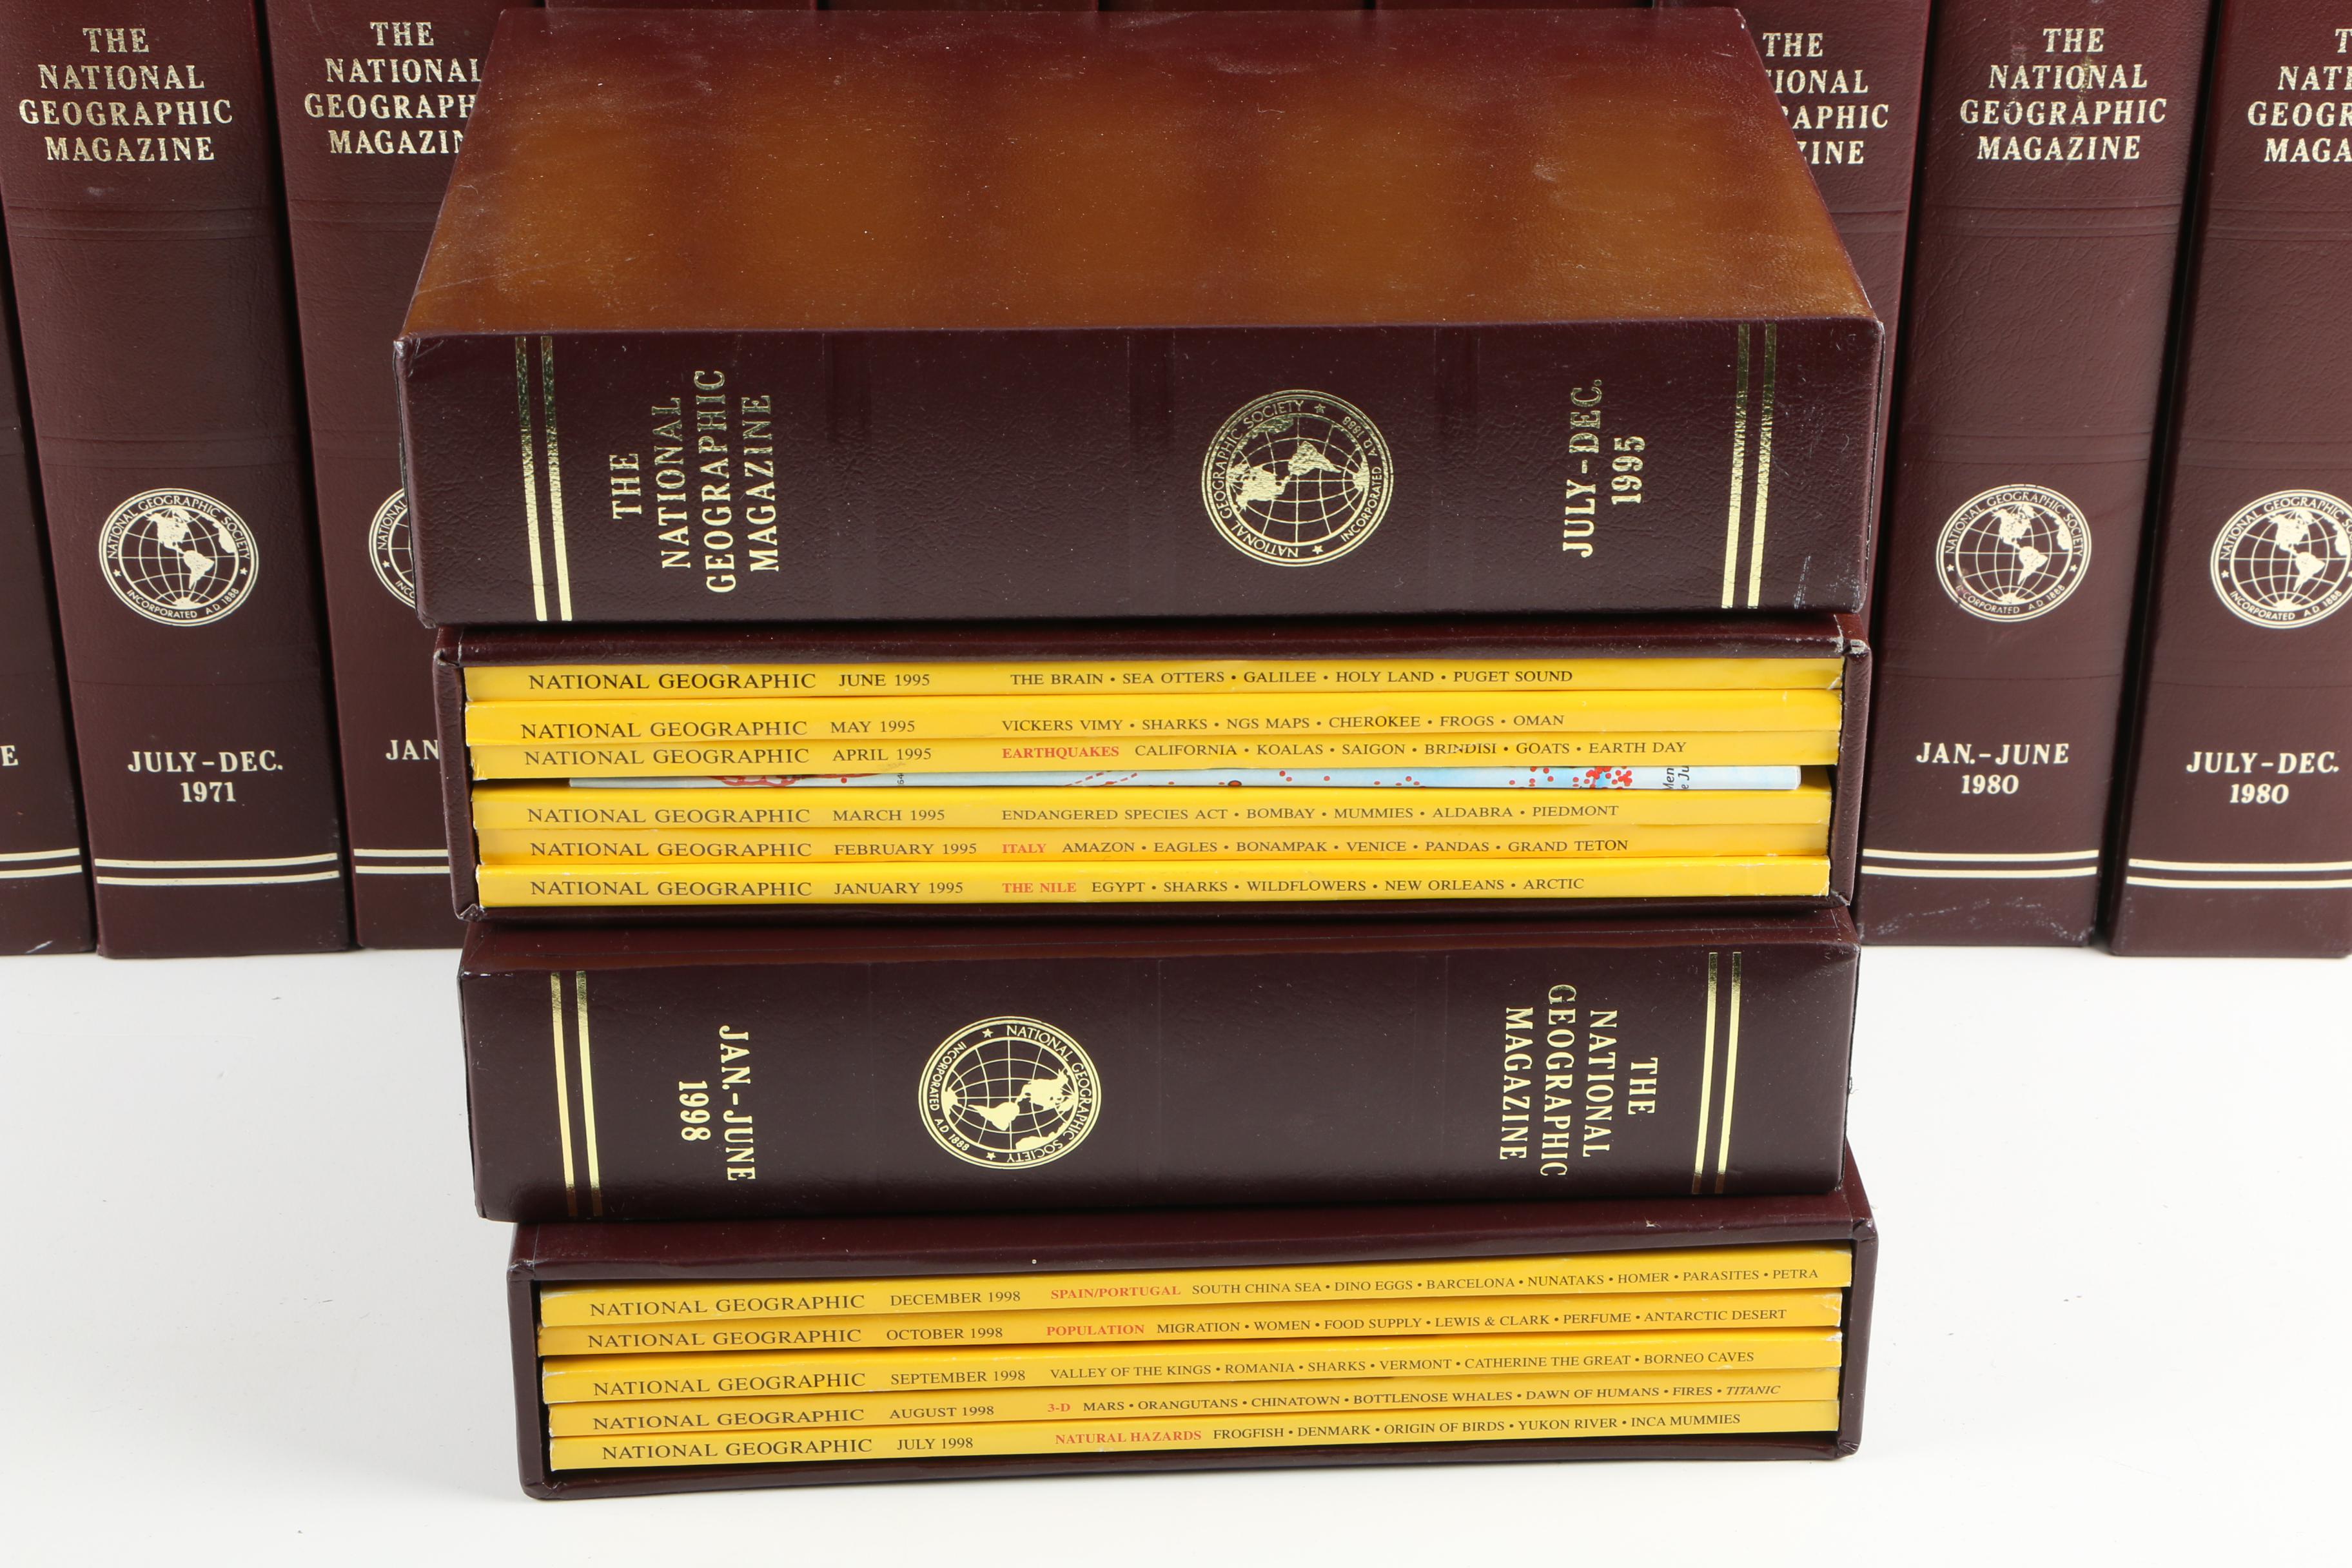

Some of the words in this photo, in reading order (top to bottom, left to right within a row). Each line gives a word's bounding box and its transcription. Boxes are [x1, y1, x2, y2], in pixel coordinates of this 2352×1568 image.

[82, 27, 150, 54] THE
[369, 21, 435, 46] THE
[1762, 32, 1823, 57] THE
[2043, 27, 2104, 53] THE
[37, 64, 205, 90] NATIONAL
[324, 57, 482, 83] NATIONAL
[1988, 63, 2148, 90] NATIONAL
[18, 99, 233, 126] GEOGRAPHIC
[304, 92, 478, 119] GEOGRAPH
[1960, 97, 2167, 126] GEOGRAPHIC
[44, 136, 215, 162] MAGAZINE
[328, 129, 464, 155] MAGAZIN
[1977, 135, 2141, 161] MAGAZINE
[1242, 399, 1304, 429] SOCIETY
[1343, 416, 1365, 438] 1888
[651, 397, 692, 569] NATIONAL
[693, 370, 737, 593] GEOGRAPHIC
[1211, 428, 1244, 520] GEOGRAPHIC
[1562, 379, 1602, 558] JULY-DEC.
[1611, 436, 1645, 505] 1995
[609, 453, 643, 520] THE
[741, 395, 779, 573] MAGAZINE
[1340, 466, 1382, 542] INCORPORATED
[108, 509, 139, 559] NATIONAL
[138, 495, 220, 518] GEOGRAPHIC
[221, 516, 251, 560] SOCIETY
[377, 500, 407, 550] NATIONAL
[1231, 520, 1299, 558] NATIONAL
[1945, 504, 1985, 554] NATIONAL
[1986, 491, 2065, 514] GEOGRAPHIC
[2064, 513, 2083, 557] SOCIETY
[2220, 510, 2262, 560] NATIONAL
[2264, 496, 2344, 519] GEOGRAPHIC
[127, 589, 197, 618] INCORPORATED
[221, 588, 239, 604] 1888
[2046, 584, 2066, 601] 1888
[2230, 591, 2295, 621] INCORPORATED
[2322, 590, 2342, 607] 1888
[528, 674, 650, 690] NATIONAL
[658, 673, 816, 689] GEOGRAPHIC
[838, 674, 887, 687] JUNE
[895, 674, 930, 687] 1995
[1010, 674, 1044, 685] THE
[1051, 673, 1103, 685] BRAIN
[1122, 673, 1155, 685] SEA
[1161, 671, 1225, 684] OTTERS
[1243, 671, 1317, 683] GALILEE
[1336, 671, 1381, 683] HOLY
[1387, 671, 1435, 683] LAND
[1453, 671, 1510, 683] PUGET
[1514, 671, 1573, 682] SOUND
[127, 749, 284, 773] JULY-DEC.
[524, 750, 645, 765] NATIONAL
[652, 748, 809, 764] GEOGRAPHIC
[832, 749, 888, 761] APRIL
[897, 748, 932, 760] 1995
[1003, 746, 1119, 760] EARTHQUAKES
[1135, 744, 1238, 756] CALIFORNIA
[1257, 744, 1324, 756] KOALAS
[1342, 743, 1405, 755] SAIGON
[1424, 743, 1496, 755] BRINDISI
[1516, 742, 1570, 754] GOATS
[1589, 742, 1646, 754] EARTH
[1652, 741, 1687, 753] DAY
[1916, 741, 2070, 766] JAN.-JUNE
[2186, 750, 2340, 774] JULY-DEC.
[180, 781, 237, 803] 1971
[1961, 774, 2019, 795] 1980
[2230, 783, 2289, 805] 1980
[527, 808, 646, 823] NATIONAL
[654, 808, 810, 823] GEOGRAPHIC
[833, 809, 902, 821] MARCH
[911, 809, 945, 821] 1995
[1002, 809, 1118, 820] ENDANGERED
[1124, 809, 1188, 820] SPECIES
[1195, 809, 1228, 819] ACT
[1246, 808, 1315, 819] BOMBAY
[1334, 807, 1413, 819] MUMMIES
[1432, 807, 1513, 818] ALDABRA
[1533, 805, 1619, 817] PIEDMONT
[530, 881, 649, 896] NATIONAL
[657, 881, 812, 896] GEOGRAPHIC
[834, 882, 920, 895] JANUARY
[929, 882, 963, 894] 1995
[1002, 883, 1034, 893] THE
[1040, 882, 1076, 893] NILE
[1092, 881, 1146, 893] EGYPT
[1164, 881, 1228, 892] SHARKS
[1246, 880, 1366, 892] WILDFLOWERS
[1385, 880, 1422, 891] NEW
[1427, 879, 1504, 891] ORLEANS
[1523, 878, 1584, 890] ARCTIC
[1006, 1024, 1073, 1062] NATIONAL
[1499, 1007, 1534, 1160] MAGAZINE
[1540, 984, 1577, 1176] GEOGRAPHIC
[1582, 1010, 1618, 1157] NATIONAL
[1627, 1057, 1659, 1115] THE
[678, 1080, 712, 1141] 1998
[718, 1024, 756, 1181] JAN.-JUNE
[929, 1041, 967, 1111] INCORPORATED
[948, 1133, 970, 1151] 1888
[1063, 1062, 1092, 1140] GEOGRAPHIC
[1006, 1140, 1063, 1162] SOCIETY
[589, 1300, 709, 1317] NATIONAL
[715, 1295, 865, 1313] GEOGRAPHIC
[890, 1292, 983, 1306] DECEMBER
[988, 1290, 1021, 1303] 1998
[1050, 1286, 1181, 1300] SPAIN/PORTUGAL
[1191, 1284, 1241, 1295] SOUTH
[1244, 1282, 1291, 1294] CHINA
[1294, 1282, 1322, 1293] SEA
[1334, 1281, 1371, 1292] DINO
[1375, 1280, 1413, 1291] EGGS
[1426, 1277, 1515, 1289] BARCELONA
[1527, 1274, 1604, 1287] NUNATAKS
[1618, 1272, 1670, 1284] HOMER
[1683, 1269, 1759, 1282] PARASITES
[1772, 1268, 1819, 1279] PETRA
[593, 1378, 710, 1396] NATIONAL
[718, 1373, 866, 1392] GEOGRAPHIC
[890, 1371, 988, 1386] SEPTEMBER
[994, 1369, 1026, 1382] 1998
[1050, 1367, 1108, 1379] VALLEY
[1110, 1367, 1130, 1377] OF
[1133, 1366, 1163, 1377] THE
[1166, 1364, 1211, 1376] KINGS
[1224, 1362, 1295, 1374] ROMANIA
[1308, 1360, 1366, 1373] SHARKS
[1379, 1358, 1453, 1371] VERMONT
[1464, 1357, 1547, 1369] CATHERINE
[1550, 1356, 1580, 1367] THE
[1583, 1355, 1632, 1366] GREAT
[1643, 1352, 1705, 1365] BORNEO
[1707, 1351, 1754, 1363] CAVES
[602, 1444, 718, 1460] NATIONAL
[725, 1438, 872, 1456] GEOGRAPHIC
[896, 1438, 936, 1451] JULY
[941, 1436, 974, 1449] 1998
[1055, 1433, 1127, 1445] NATURAL
[1130, 1430, 1202, 1442] HAZARDS
[1213, 1427, 1284, 1440] FROGFISH
[1297, 1425, 1371, 1437] DENMARK
[1384, 1423, 1436, 1435] ORIGIN
[1439, 1422, 1459, 1433] OF
[1462, 1420, 1505, 1433] BIRDS
[1517, 1419, 1571, 1431] YUKON
[1574, 1418, 1618, 1429] RIVER
[1631, 1416, 1667, 1427] INCA
[1669, 1413, 1741, 1426] MUMMIES
